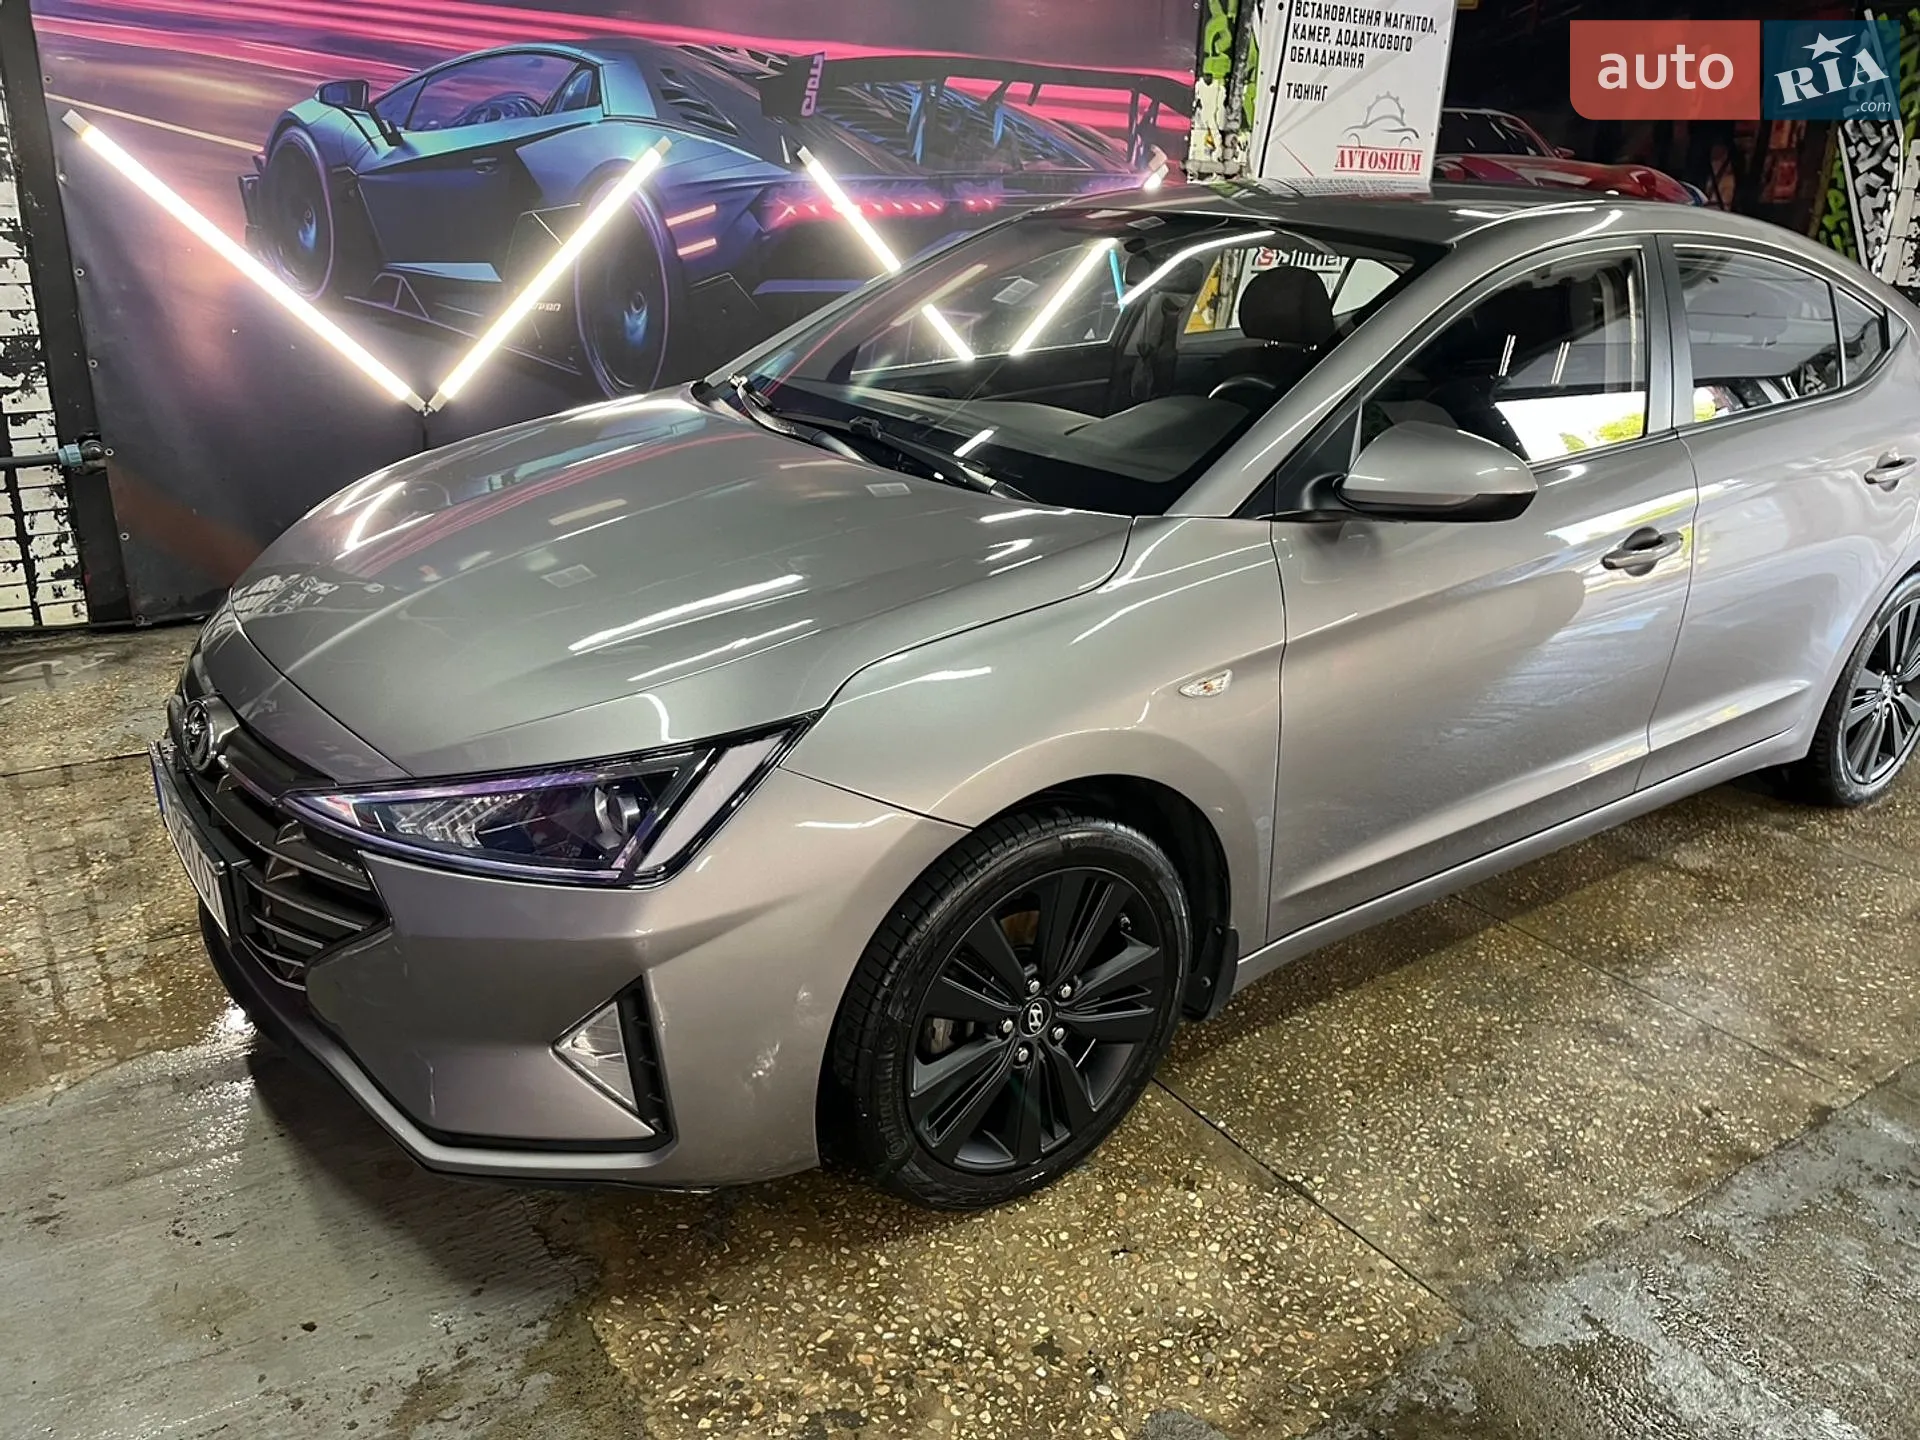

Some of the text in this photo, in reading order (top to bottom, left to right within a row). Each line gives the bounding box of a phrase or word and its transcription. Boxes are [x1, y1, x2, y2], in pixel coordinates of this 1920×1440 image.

[1295, 1, 1437, 34] ВСТАНОВЛЕННЯ МАГНІТОЛ,
[1292, 23, 1413, 52] КАМЕР, ДОДАТКОВОГО
[1290, 46, 1364, 69] ОБЛАДНАННЯ
[1286, 82, 1328, 101] ТЮНІНГ
[1335, 149, 1421, 171] AVTOSHUM
